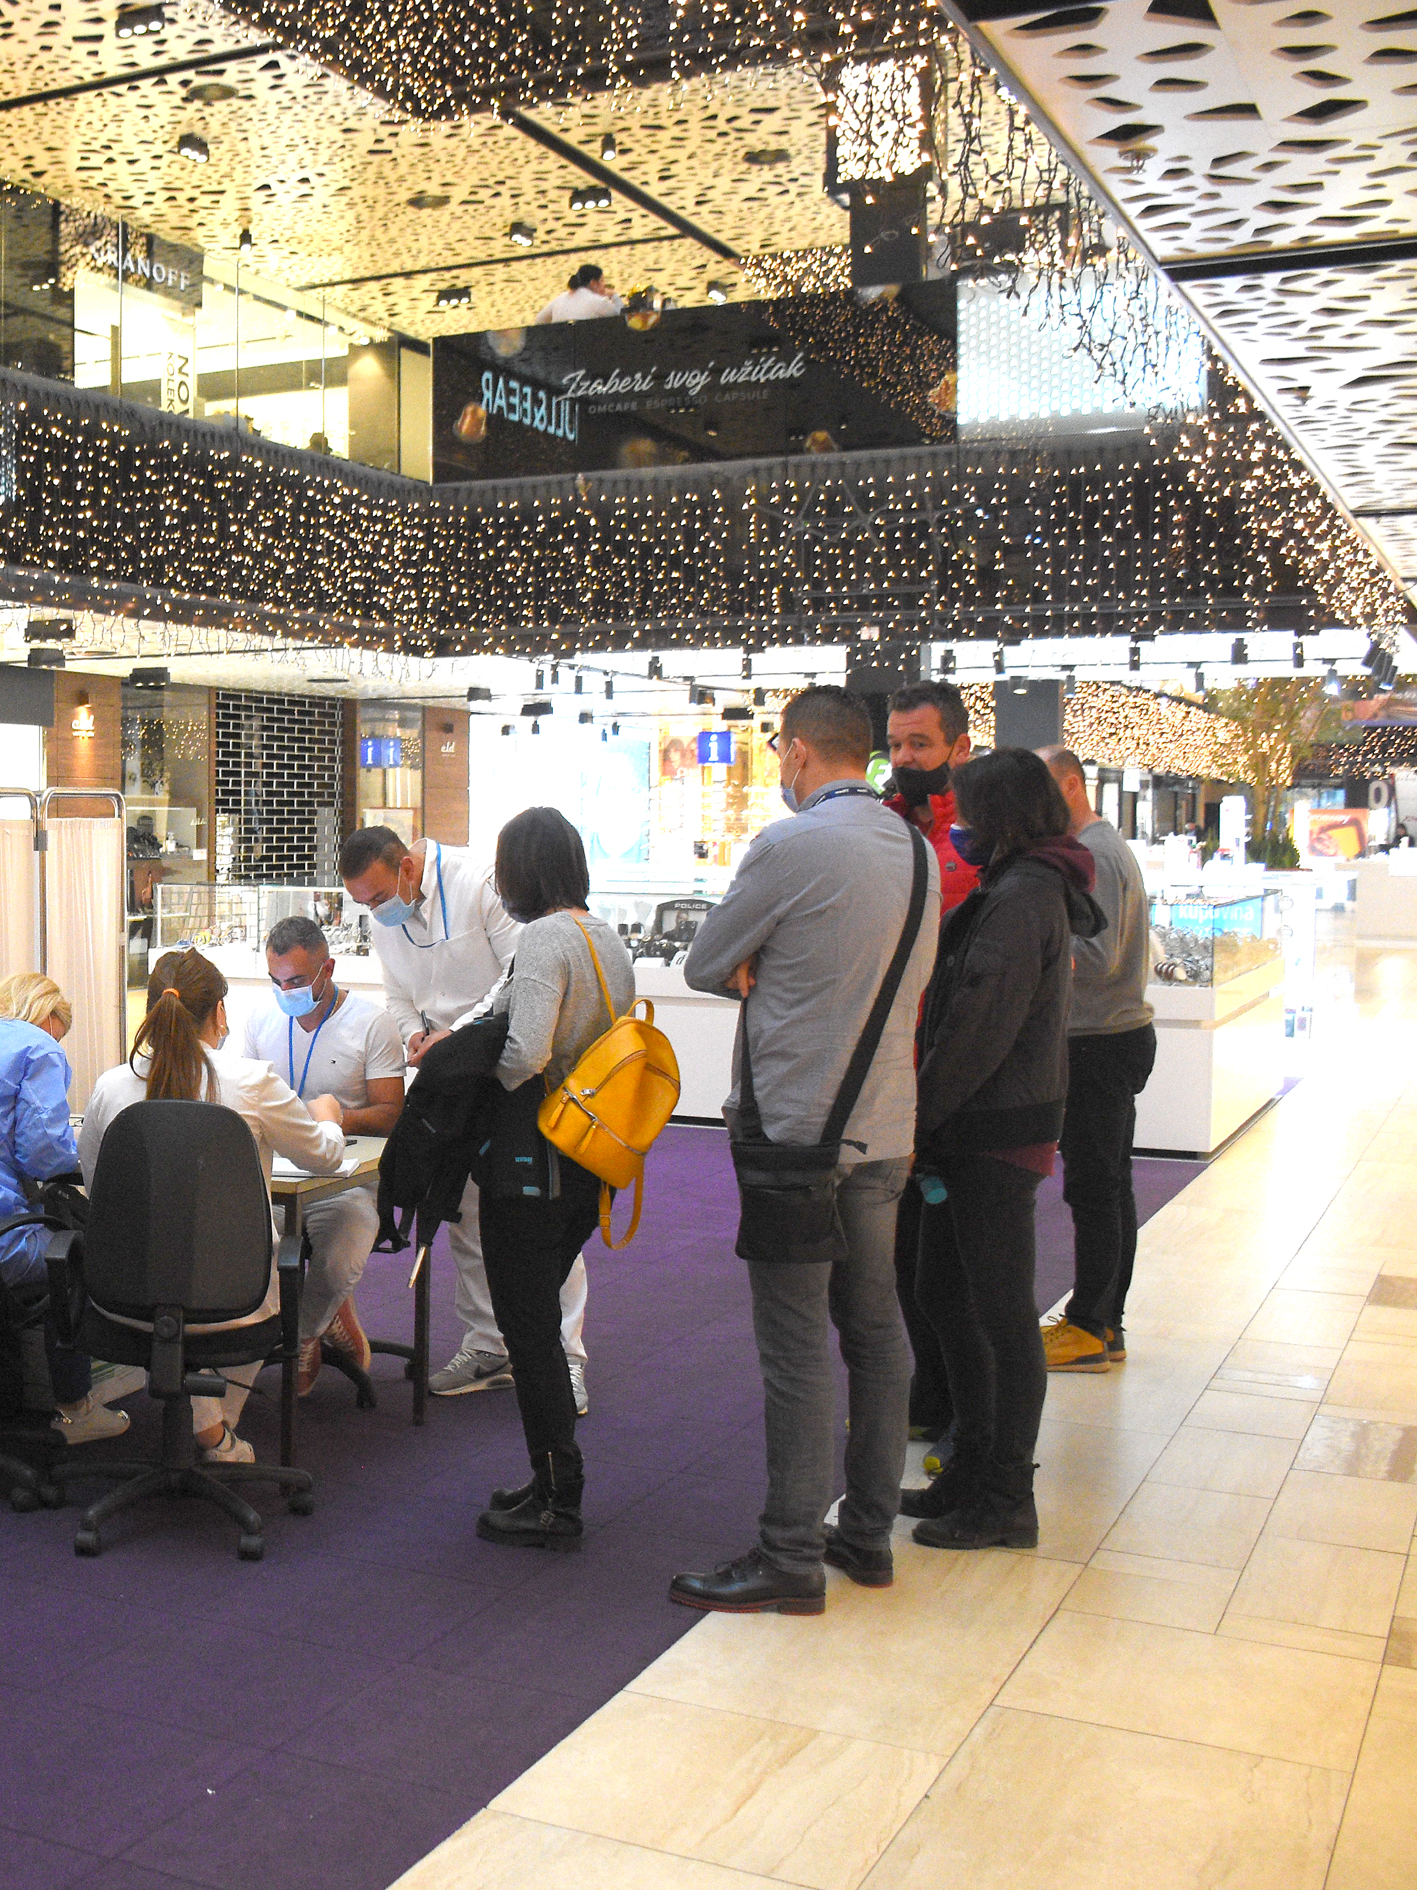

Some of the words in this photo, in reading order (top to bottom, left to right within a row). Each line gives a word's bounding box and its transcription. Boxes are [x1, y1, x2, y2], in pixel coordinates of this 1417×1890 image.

[557, 366, 658, 402] Izaberi
[664, 361, 715, 396] svoj
[720, 352, 806, 385] užitak
[1178, 904, 1254, 924] kupovina
